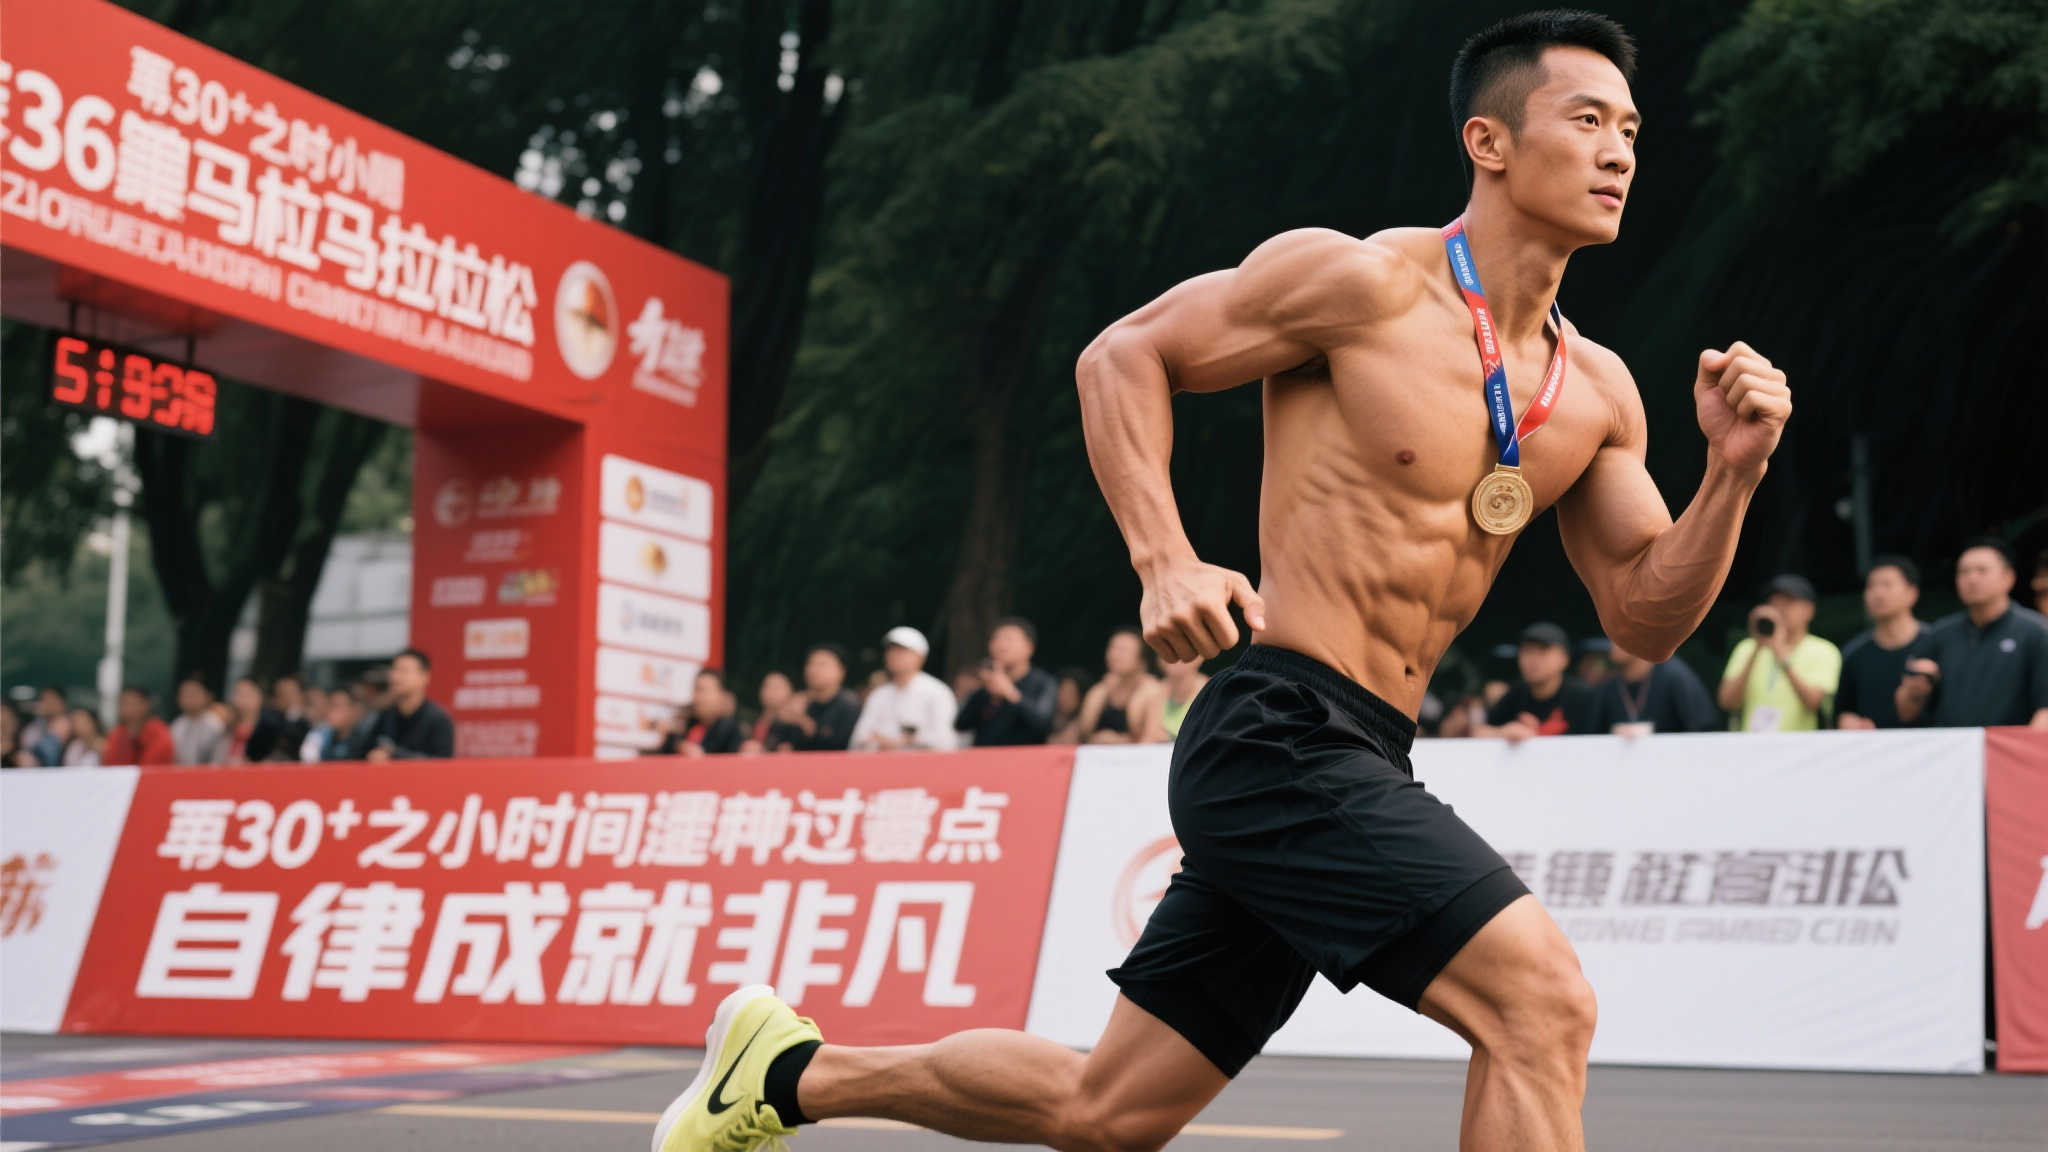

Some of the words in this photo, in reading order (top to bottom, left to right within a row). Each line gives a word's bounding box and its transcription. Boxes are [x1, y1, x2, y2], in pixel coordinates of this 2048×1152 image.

[134, 879, 978, 1009] 自律成就非凡
